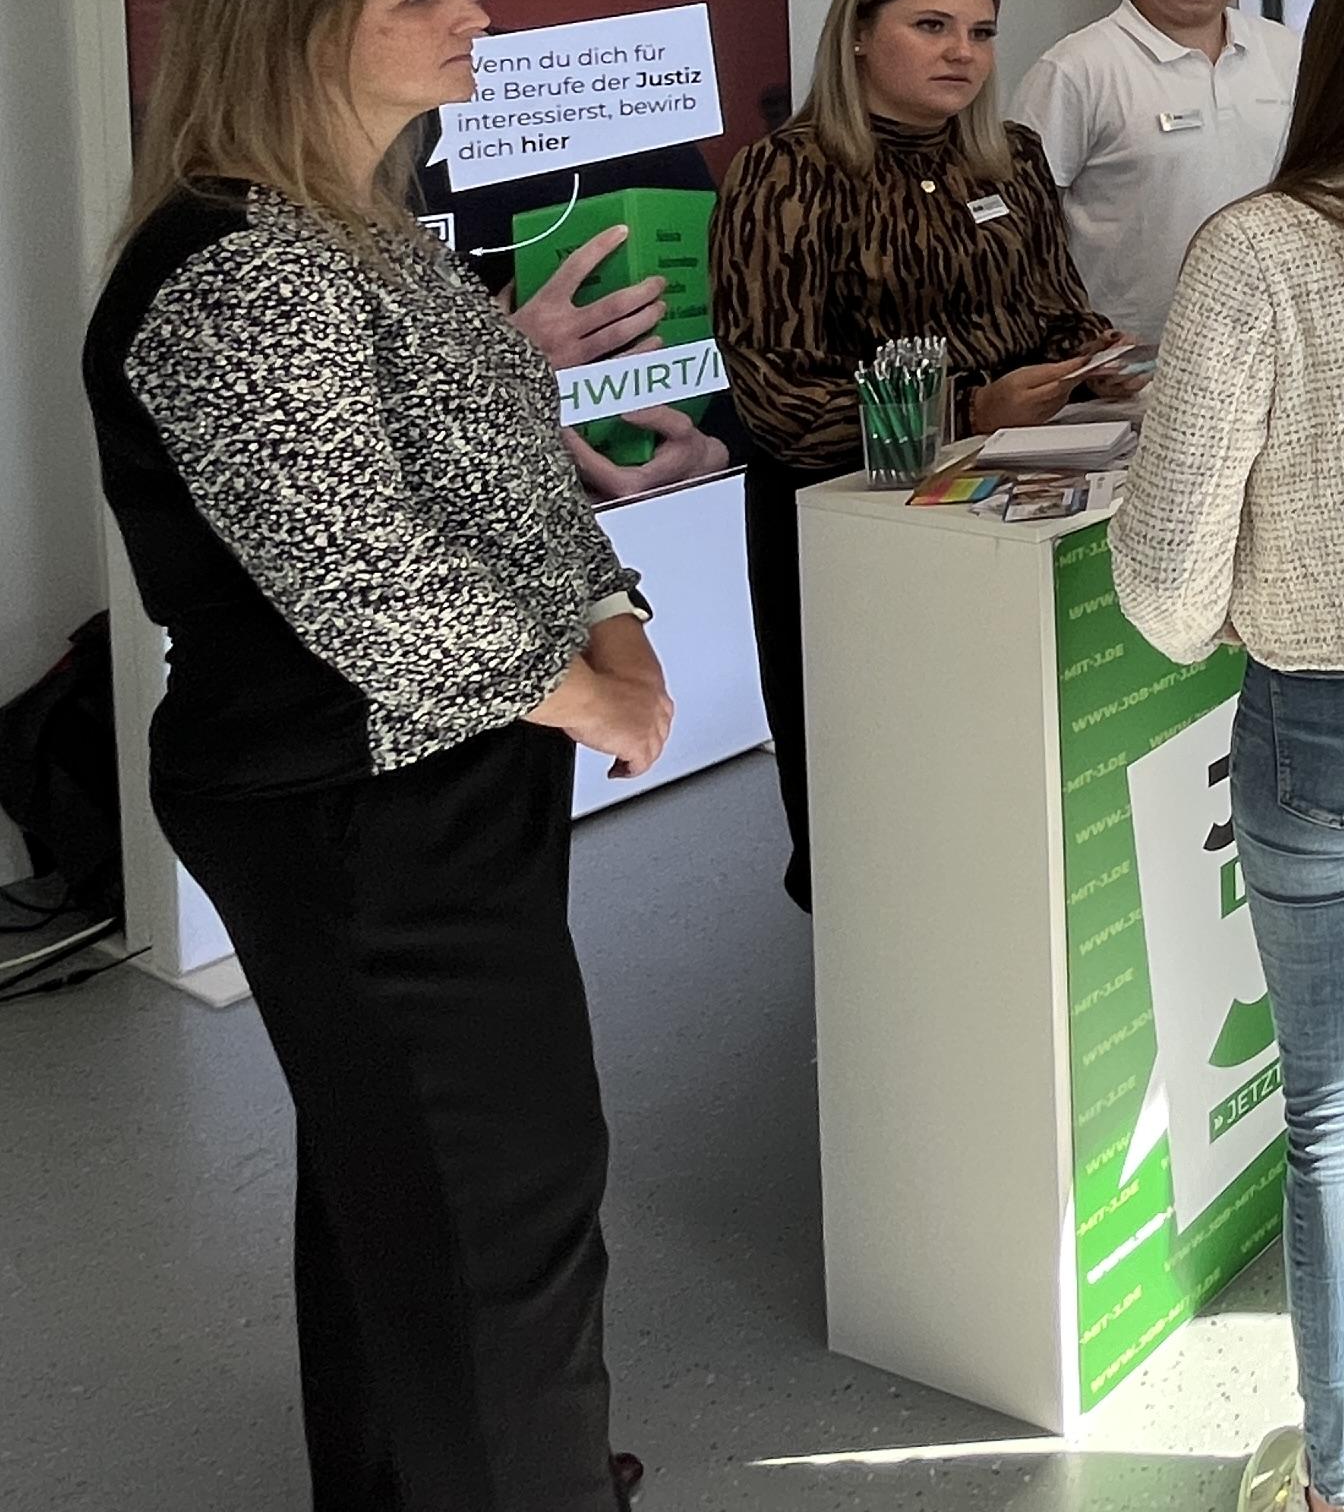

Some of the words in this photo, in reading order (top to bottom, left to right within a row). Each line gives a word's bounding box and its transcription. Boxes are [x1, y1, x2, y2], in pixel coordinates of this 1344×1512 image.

[539, 50, 571, 69] du
[577, 46, 628, 67] dich
[634, 43, 666, 63] für
[503, 76, 586, 101] Berufe
[591, 74, 631, 93] der
[635, 67, 703, 89] Justiz
[457, 103, 614, 133] interessierst,
[618, 93, 698, 117] bewirb
[458, 139, 515, 161] dich
[520, 133, 571, 155] hier
